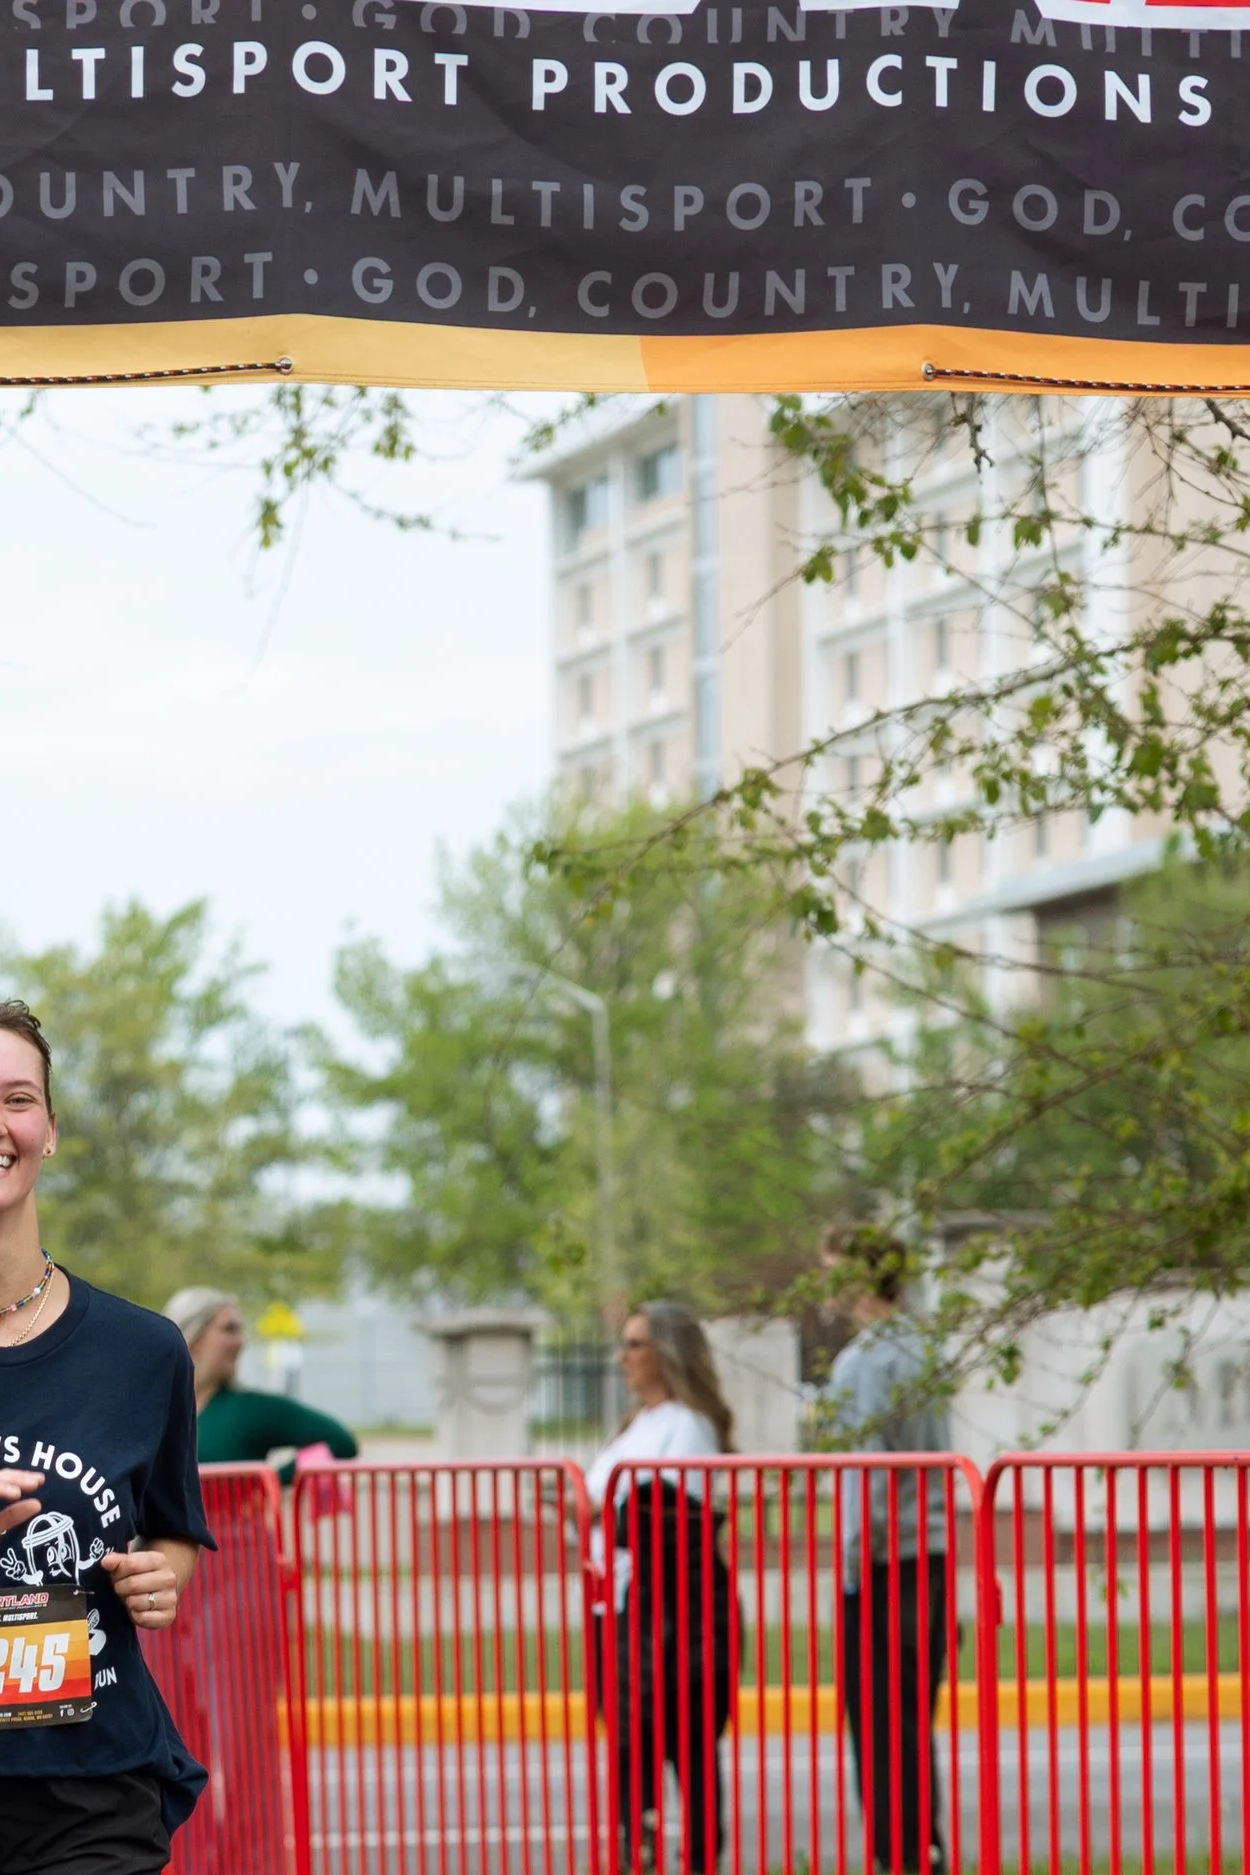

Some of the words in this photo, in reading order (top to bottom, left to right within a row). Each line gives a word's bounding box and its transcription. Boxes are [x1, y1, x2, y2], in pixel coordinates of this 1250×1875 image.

[531, 54, 1212, 126] PRODUCTIONS
[351, 169, 871, 232] MULTISPORT
[948, 179, 1131, 241] GOD,
[352, 258, 537, 318] GOD,
[578, 262, 970, 317] COUNTRY,
[1008, 271, 1239, 327] MULTI
[31, 1440, 120, 1528] HOUSE
